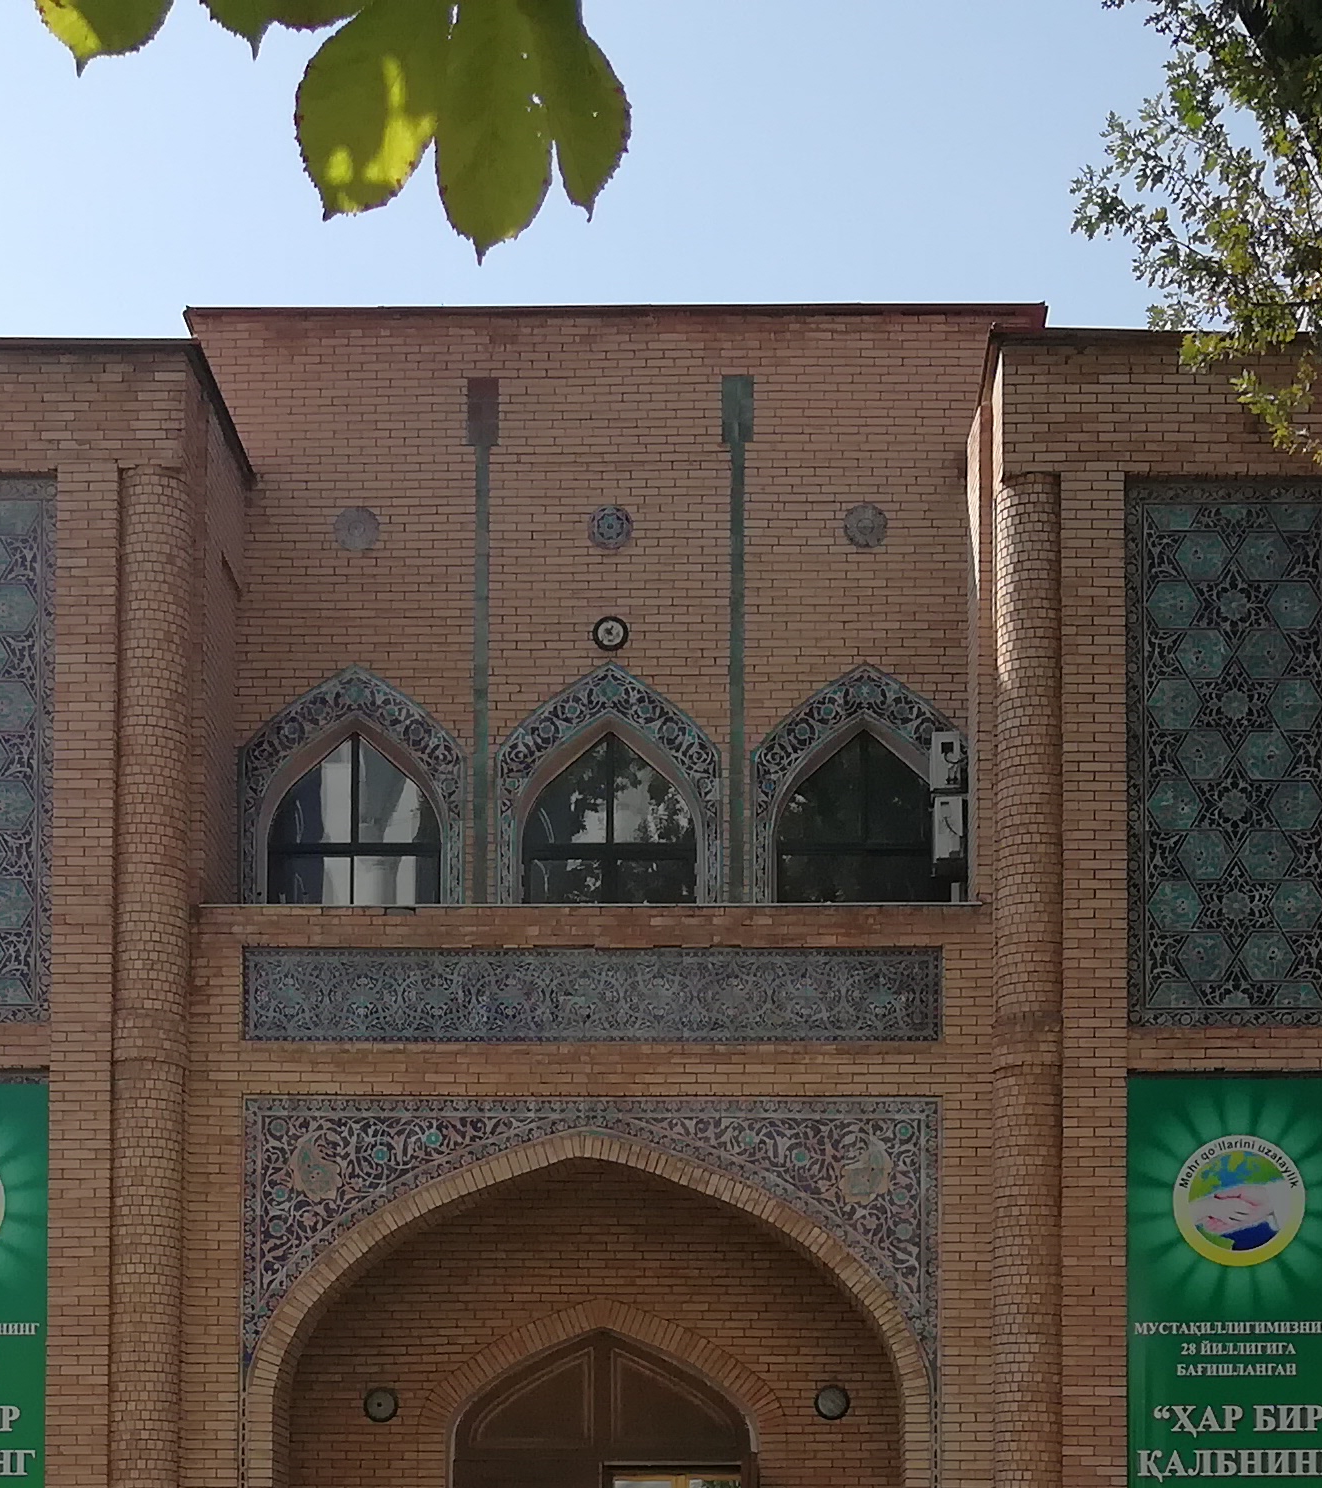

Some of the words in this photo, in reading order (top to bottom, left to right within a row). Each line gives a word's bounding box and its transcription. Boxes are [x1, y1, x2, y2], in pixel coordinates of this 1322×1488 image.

[1179, 1159, 1201, 1188] Mehr
[1257, 1144, 1299, 1188] uzataylik
[1180, 1342, 1196, 1356] 28
[1200, 1340, 1297, 1356] ЙИЛЛИГИГА
[1176, 1363, 1297, 1377] БАҒИШЛАНГАН
